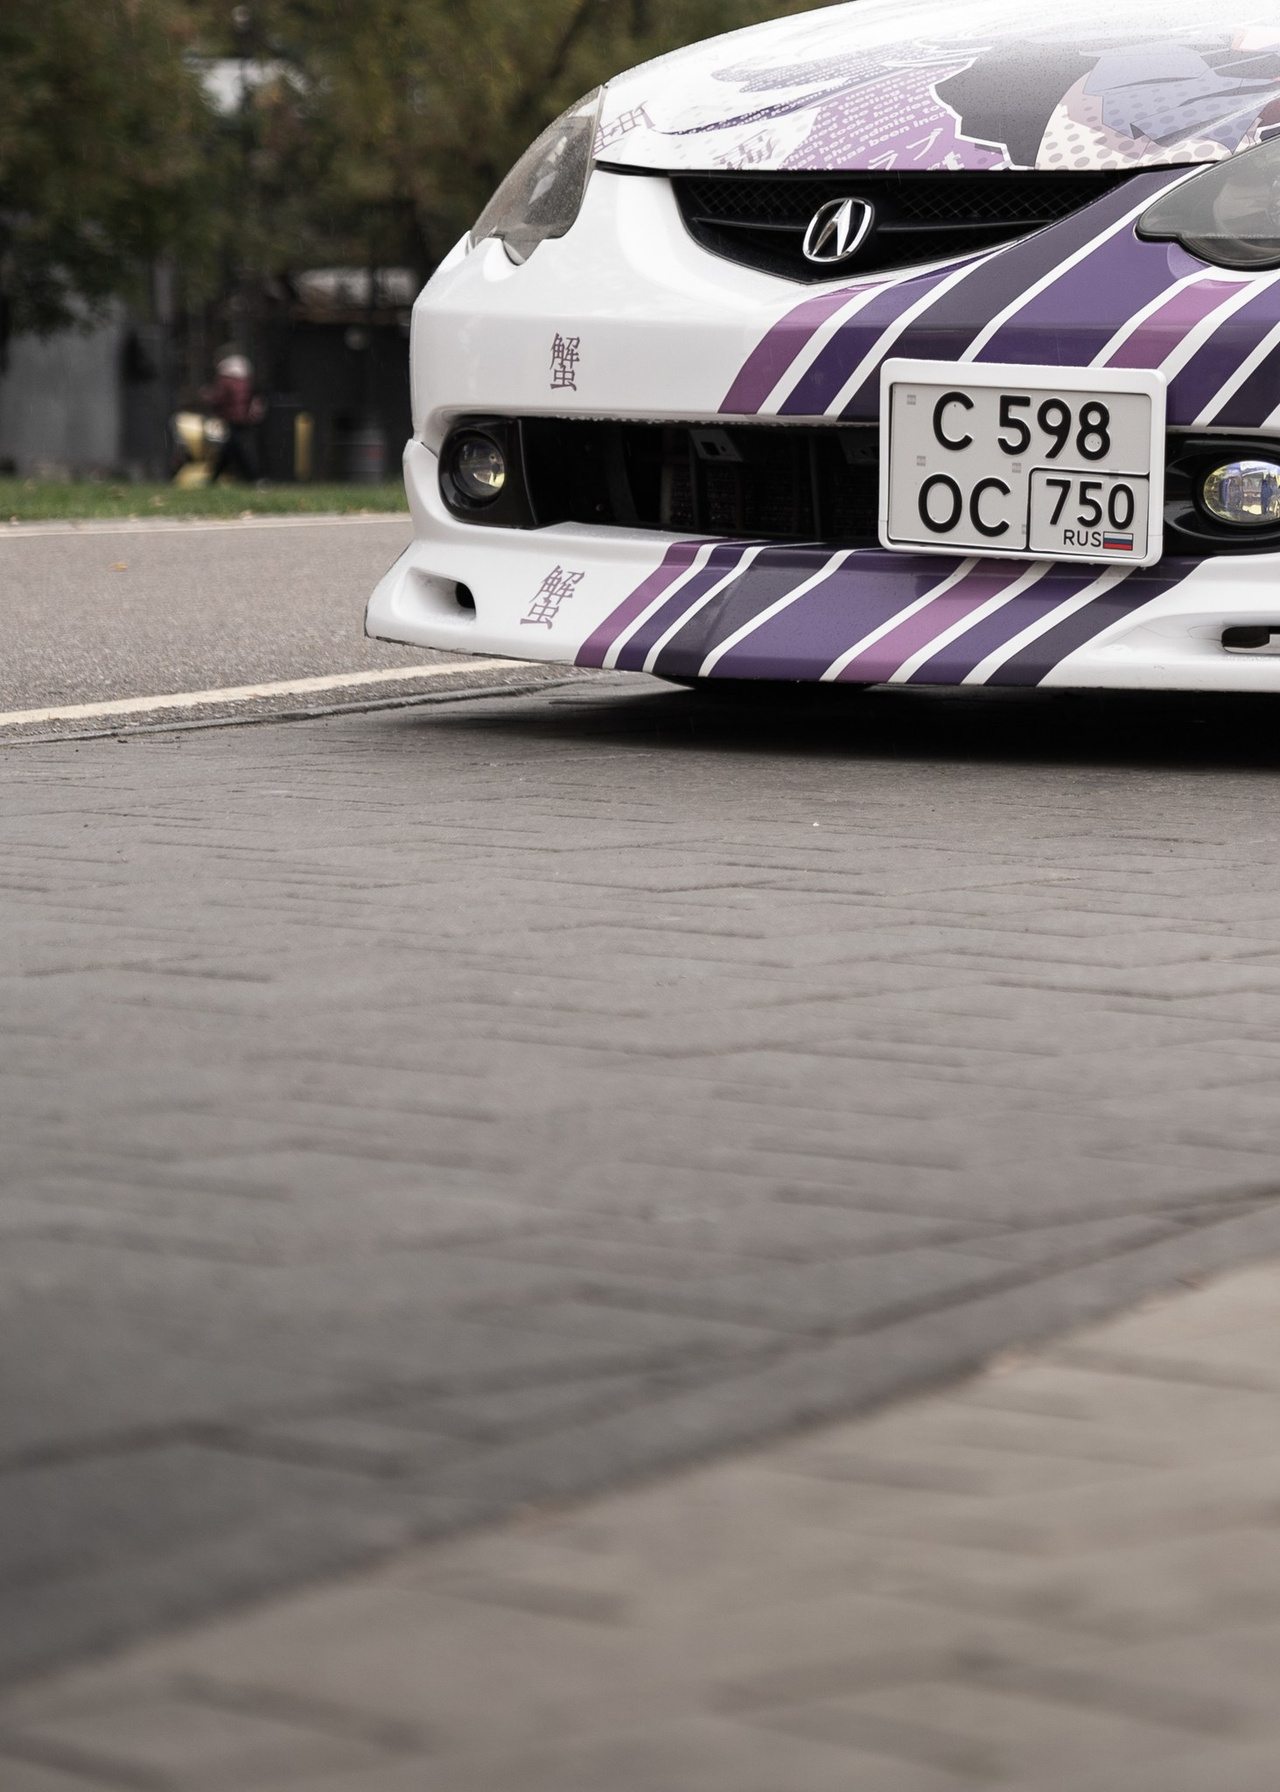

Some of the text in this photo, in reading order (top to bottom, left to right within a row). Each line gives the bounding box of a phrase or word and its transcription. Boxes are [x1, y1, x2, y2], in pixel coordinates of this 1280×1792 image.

[549, 332, 581, 393] 蟹
[997, 394, 1112, 460] 598
[1046, 478, 1135, 530] 750
[1063, 529, 1102, 548] RUS
[520, 565, 586, 630] 蟹
